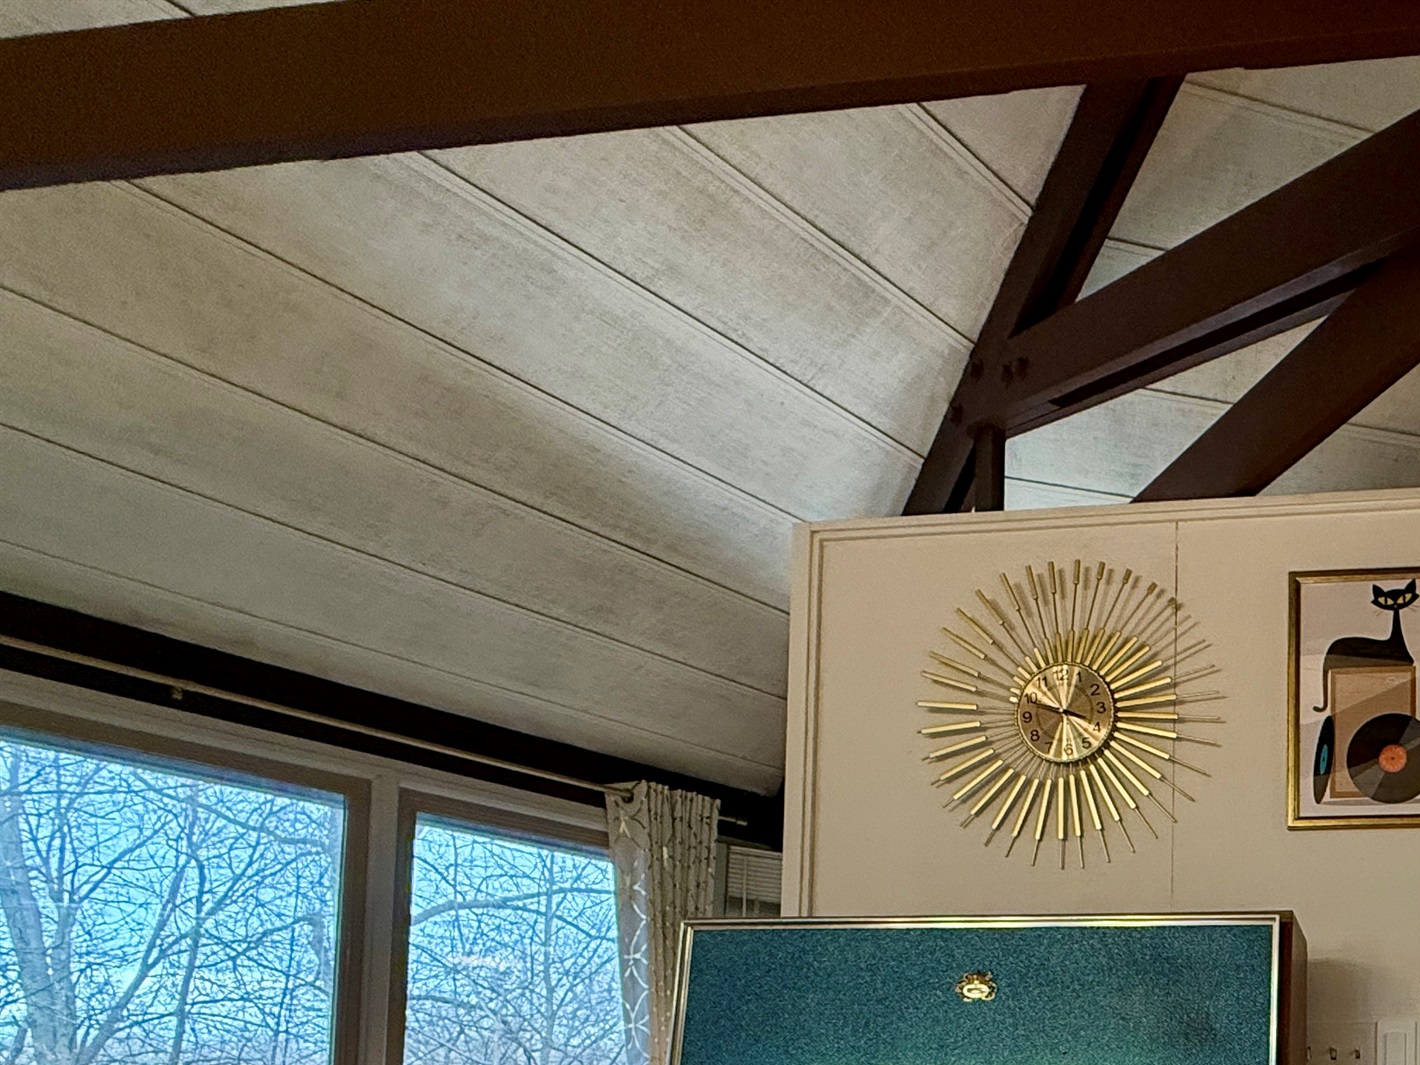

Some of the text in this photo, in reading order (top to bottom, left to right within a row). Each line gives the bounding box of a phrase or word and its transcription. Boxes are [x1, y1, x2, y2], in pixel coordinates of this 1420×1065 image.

[1036, 675, 1048, 688] 11
[1053, 669, 1069, 682] 12
[1076, 671, 1083, 683] 1
[1090, 683, 1101, 696] 2
[1024, 691, 1038, 704] 10
[1096, 701, 1107, 714] 3
[1022, 711, 1033, 723] 9
[1092, 721, 1102, 733] 4
[1030, 729, 1041, 742] 8
[1044, 741, 1054, 753] 7
[1081, 736, 1092, 749] 5
[1063, 743, 1074, 756] 6
